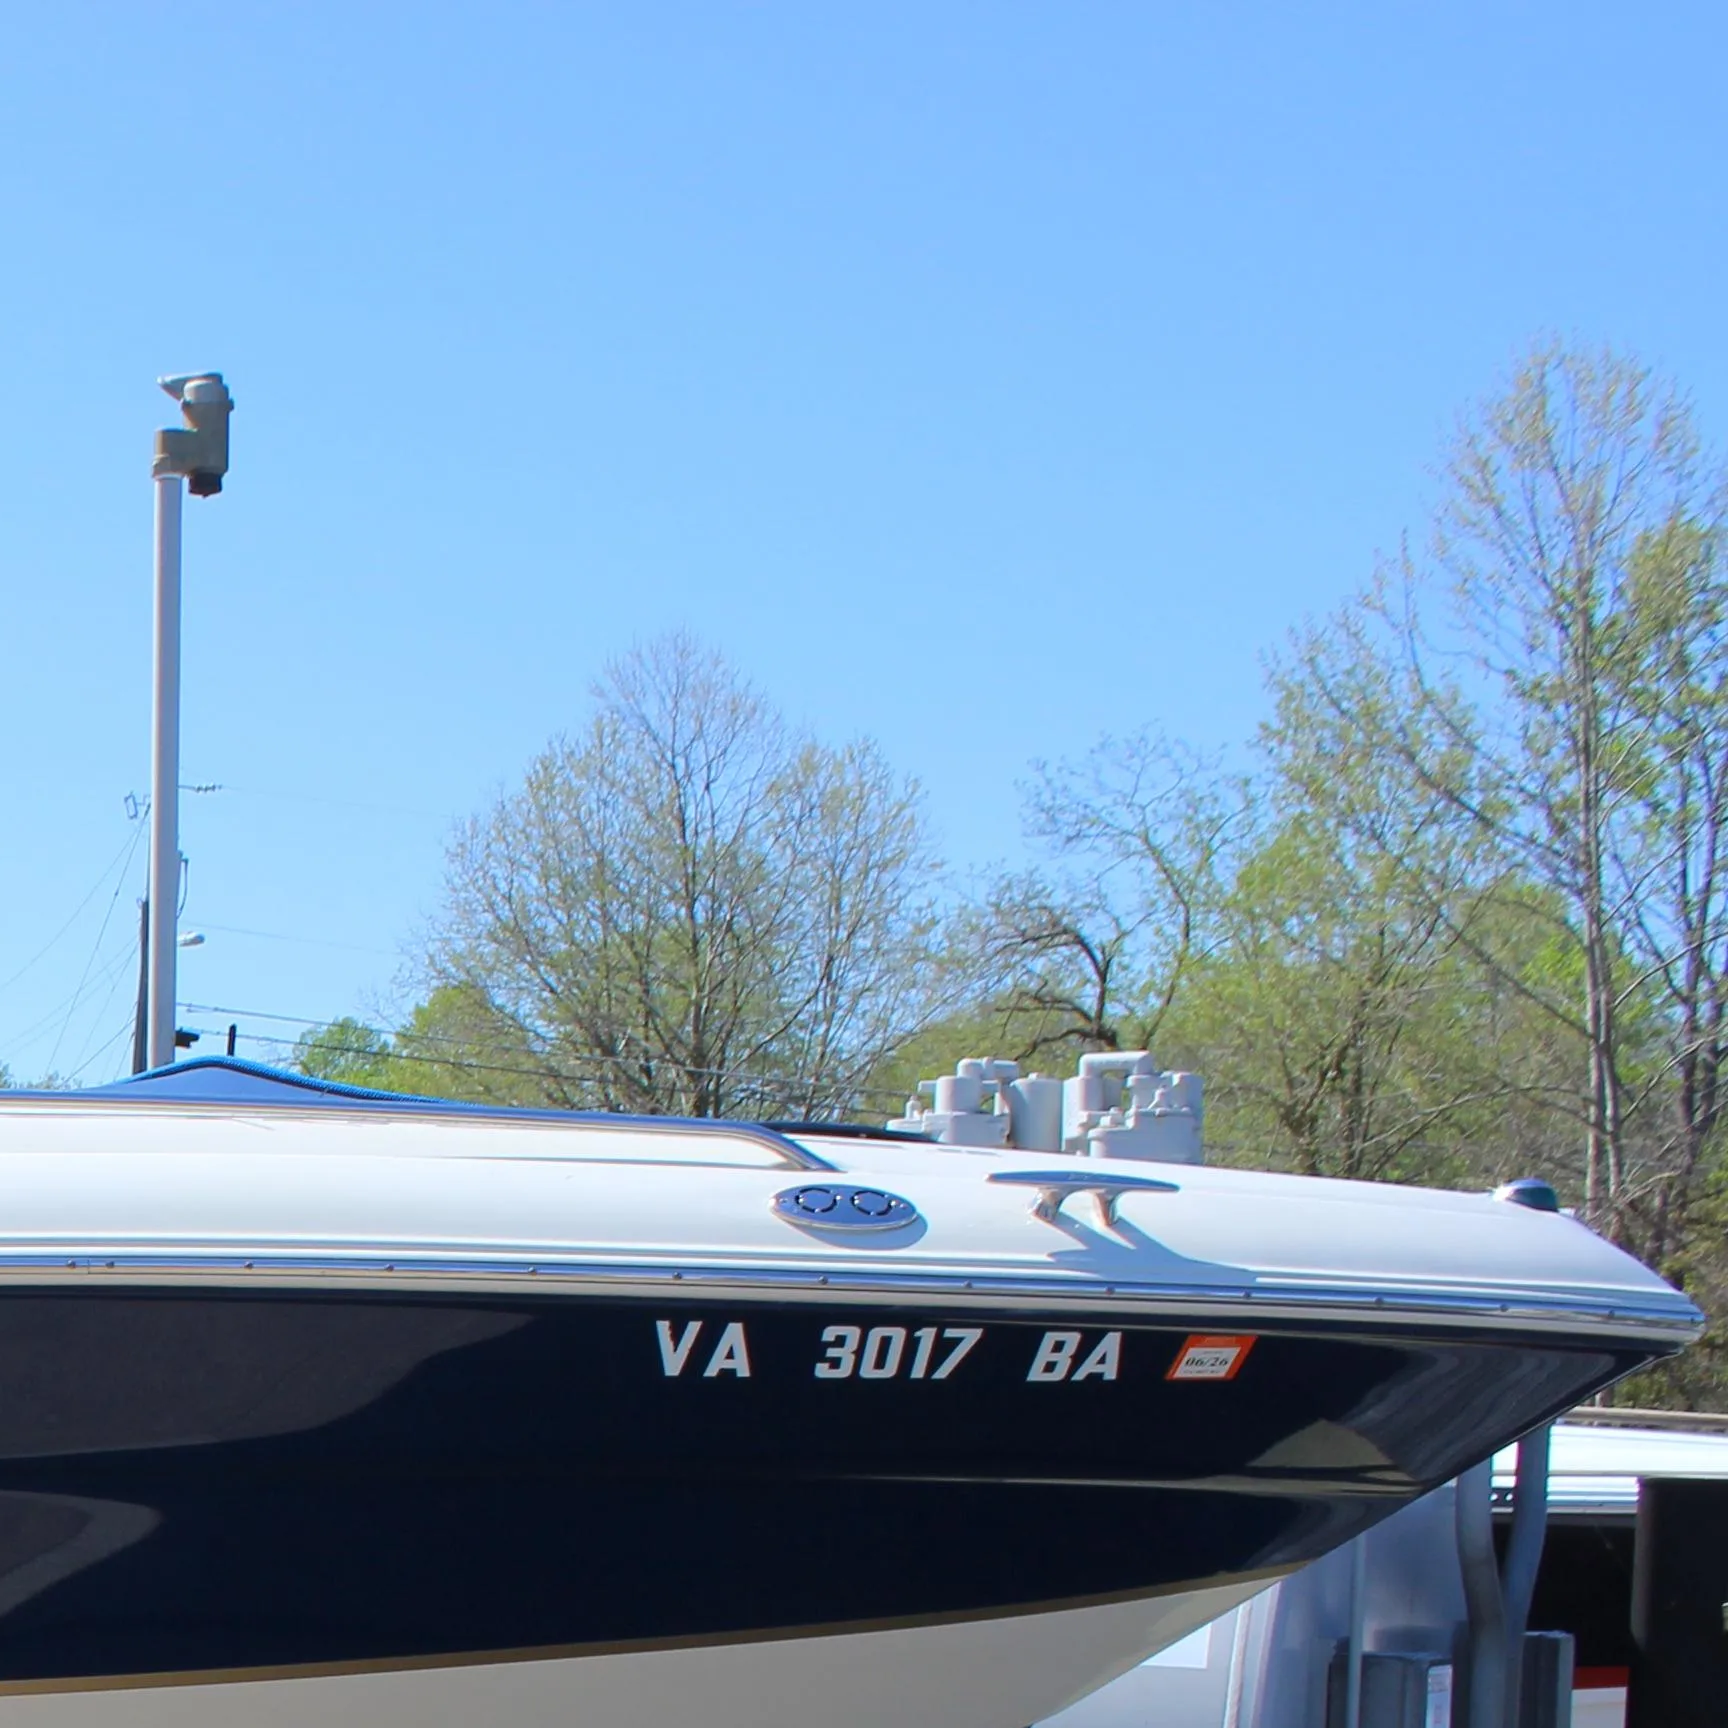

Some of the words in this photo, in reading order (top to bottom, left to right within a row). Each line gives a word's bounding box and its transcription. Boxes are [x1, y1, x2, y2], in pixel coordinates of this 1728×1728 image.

[655, 1319, 752, 1378] VA
[814, 1325, 984, 1380] 3017
[1027, 1331, 1123, 1383] BA
